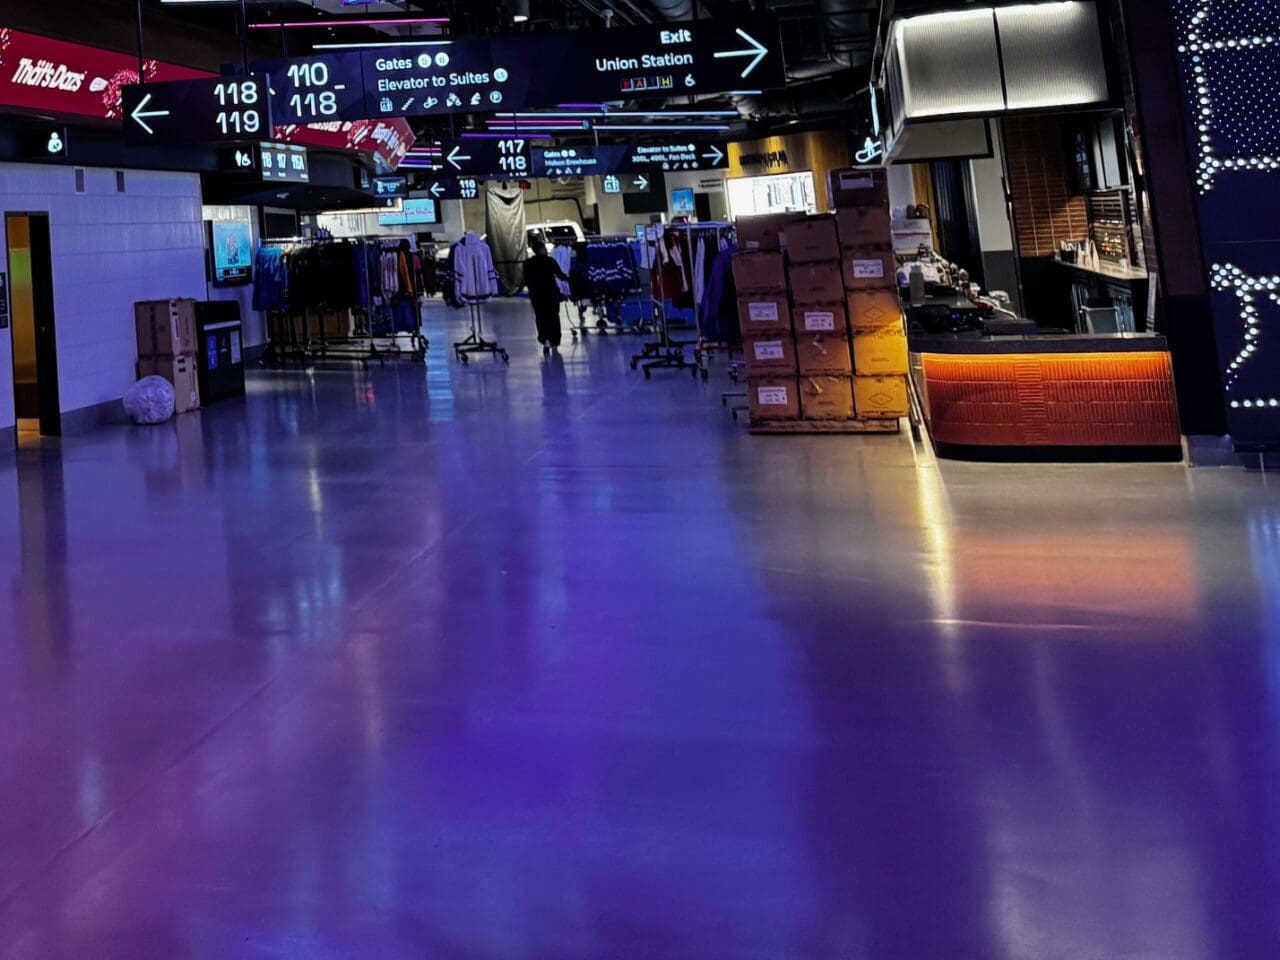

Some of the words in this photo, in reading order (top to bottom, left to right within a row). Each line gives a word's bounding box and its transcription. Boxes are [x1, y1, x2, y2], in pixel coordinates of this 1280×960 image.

[660, 29, 692, 44] Exit
[376, 58, 412, 71] Gates
[596, 57, 638, 72] Union
[642, 53, 693, 68] Station
[287, 62, 328, 88] 110
[378, 78, 429, 92] Elevator
[432, 75, 446, 87] to
[449, 72, 490, 86] Suites
[214, 81, 258, 105] 118
[289, 90, 338, 118] 118
[216, 109, 260, 135] 119
[498, 139, 525, 154] 117
[498, 155, 527, 171] 118
